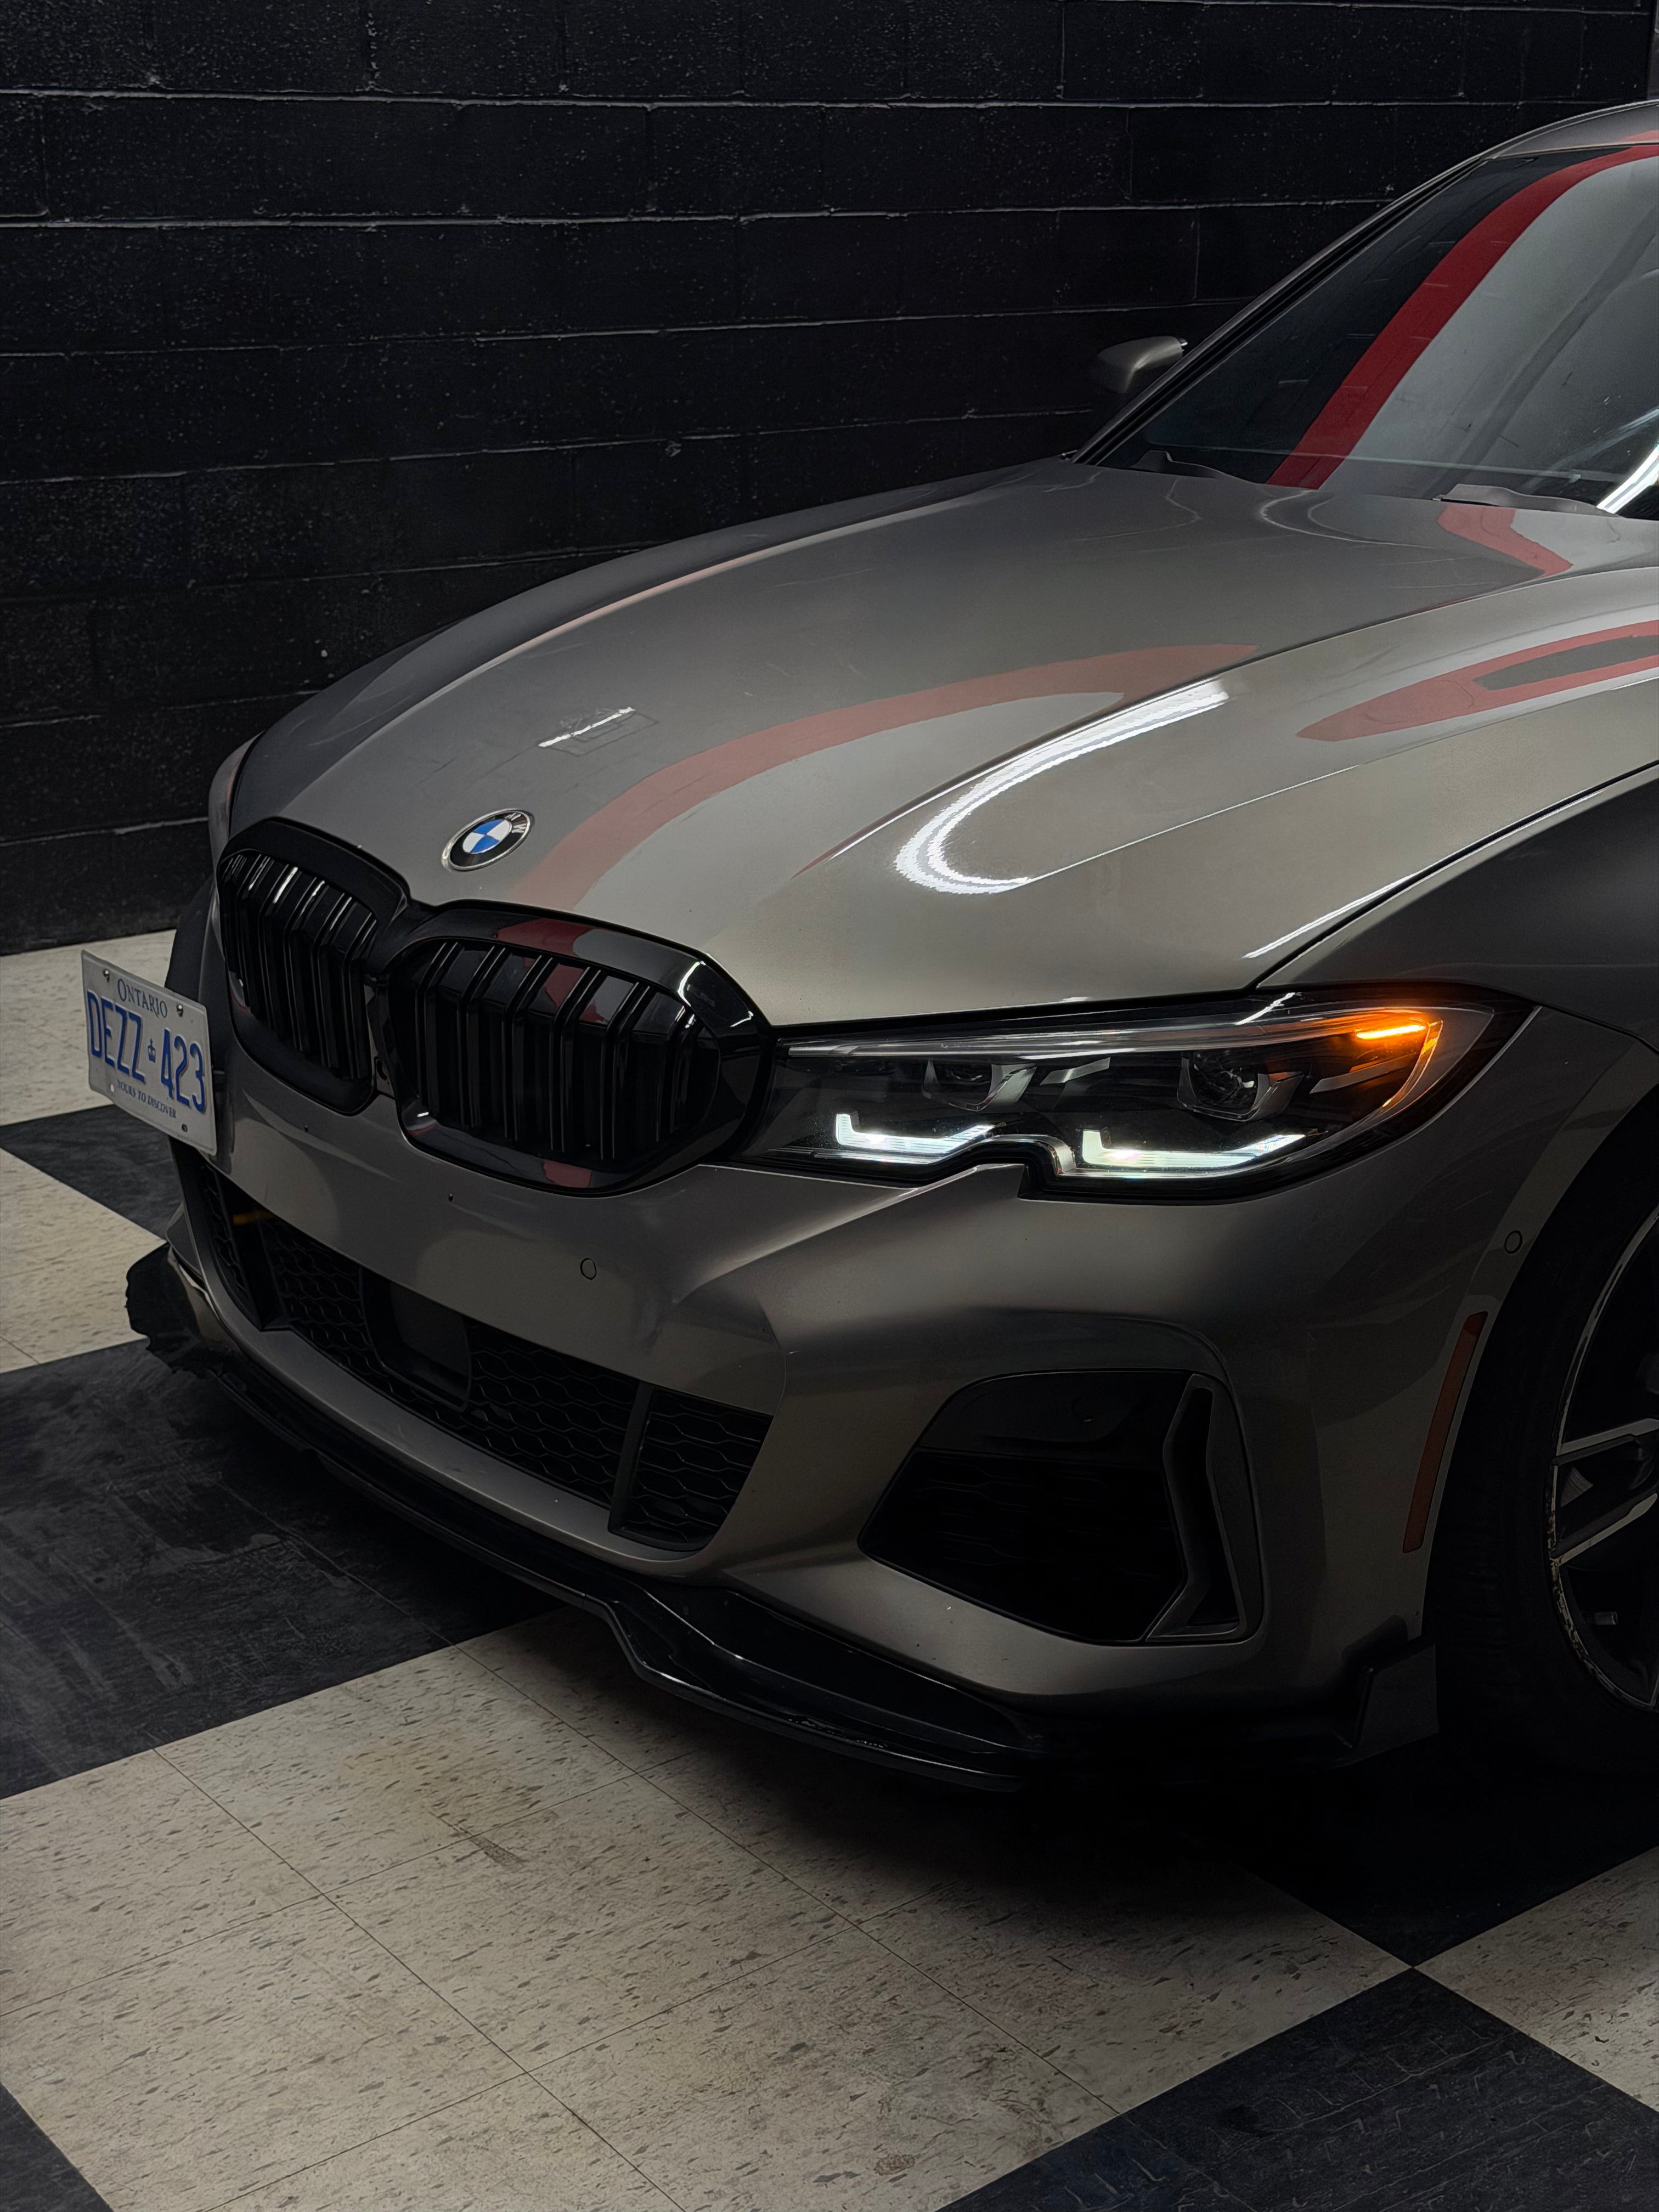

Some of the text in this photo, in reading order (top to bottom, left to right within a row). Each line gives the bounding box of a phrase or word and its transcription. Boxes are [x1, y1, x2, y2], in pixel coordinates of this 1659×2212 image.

[488, 812, 527, 833] MW
[117, 978, 167, 1018] ONTARIO
[87, 990, 206, 1113] DEZZ 423
[117, 1079, 177, 1119] YOURS TO DISCOVER
